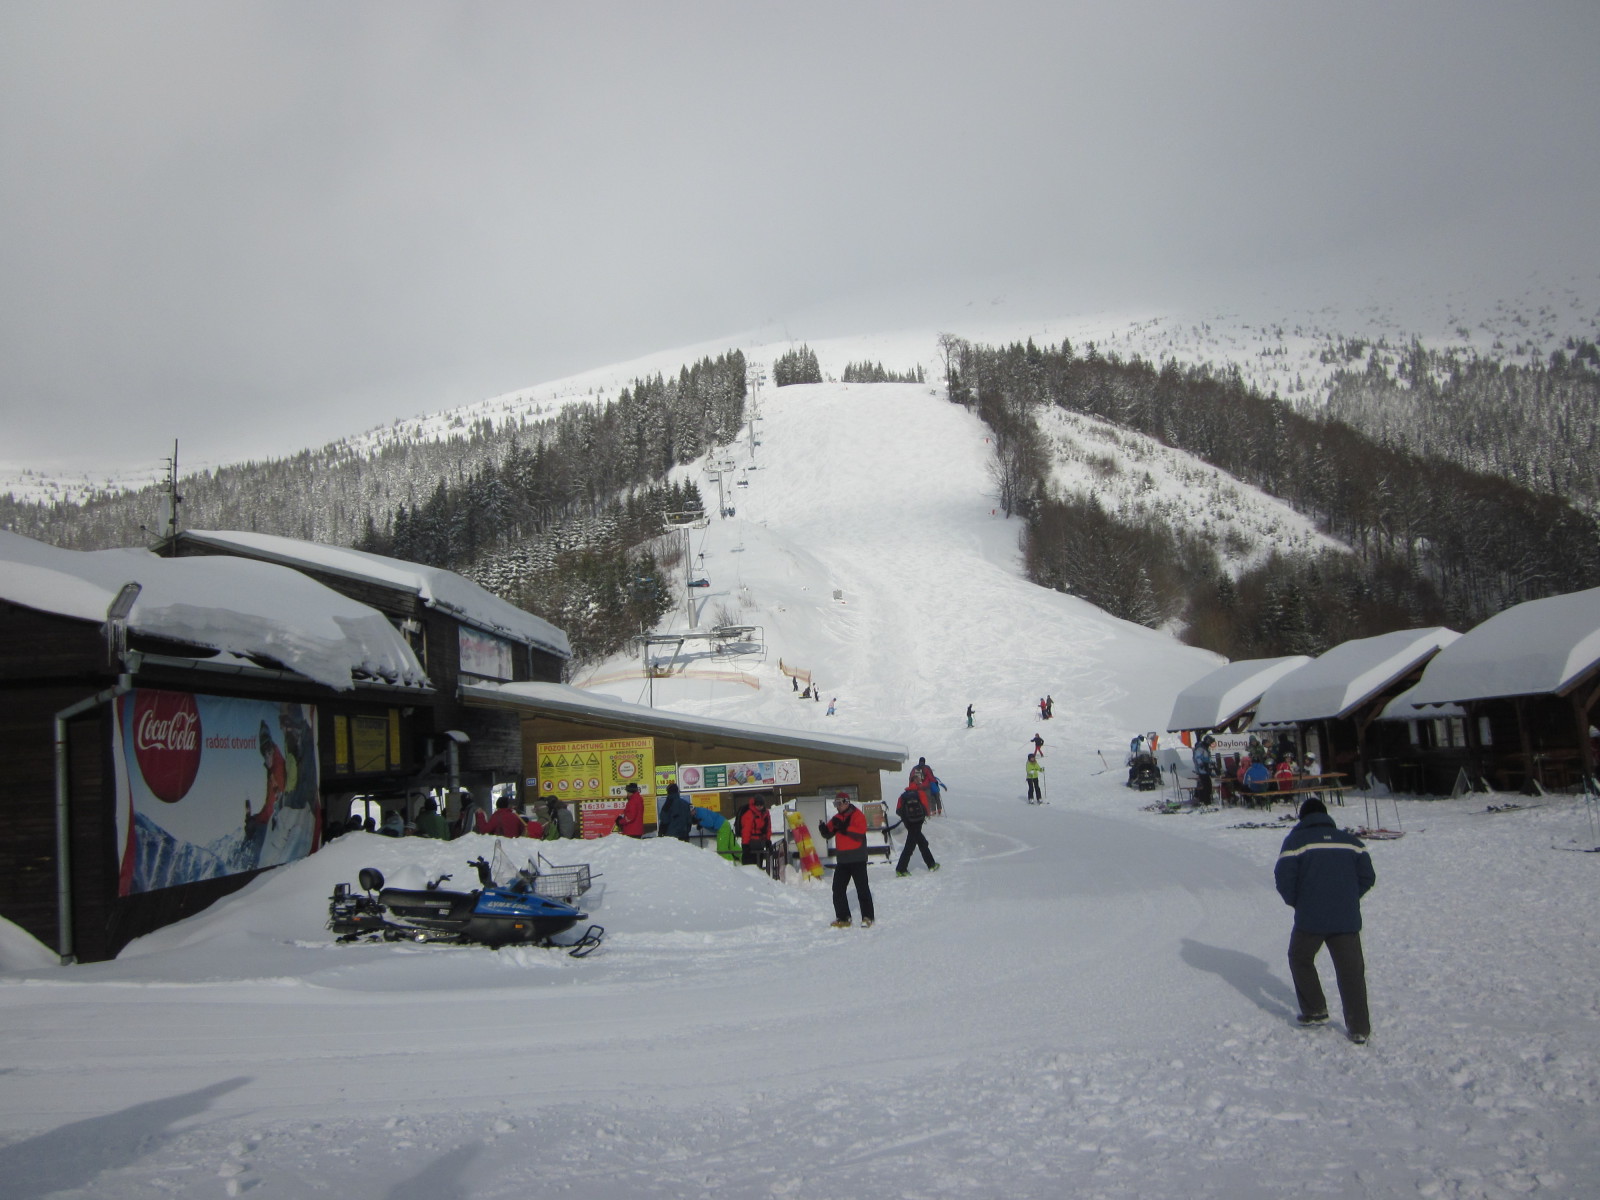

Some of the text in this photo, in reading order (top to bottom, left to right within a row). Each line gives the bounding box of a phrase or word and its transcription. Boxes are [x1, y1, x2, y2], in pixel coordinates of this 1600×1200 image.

[138, 709, 198, 751] Coca-Cola
[572, 742, 604, 750] ACHTUNG
[609, 740, 647, 748] ATTENTION
[1217, 740, 1248, 749] Daylong
